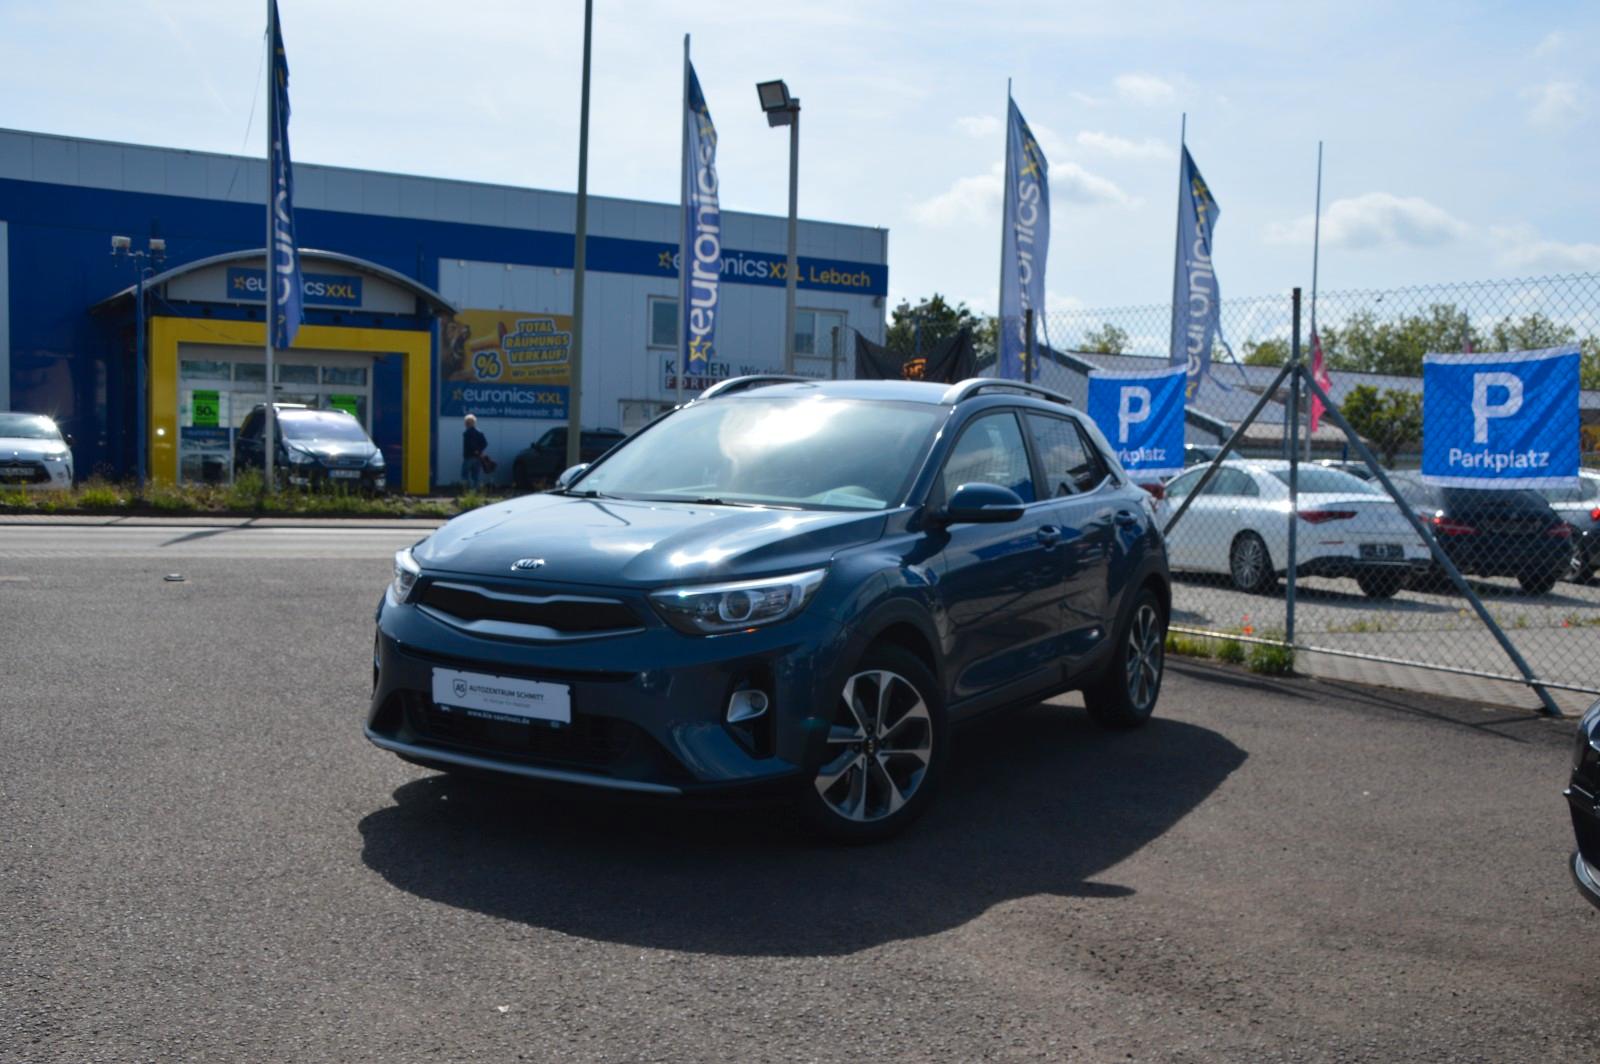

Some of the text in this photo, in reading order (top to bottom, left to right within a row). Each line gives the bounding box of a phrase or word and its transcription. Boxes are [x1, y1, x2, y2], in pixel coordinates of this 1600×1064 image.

[810, 265, 871, 287] Lebach
[519, 321, 553, 332] TOTAL
[1118, 386, 1152, 443] P
[1472, 372, 1524, 444] P
[1448, 448, 1550, 473] Parkplatz
[469, 685, 515, 697] AUTOZENTRUM
[516, 690, 545, 702] SCHMITT
